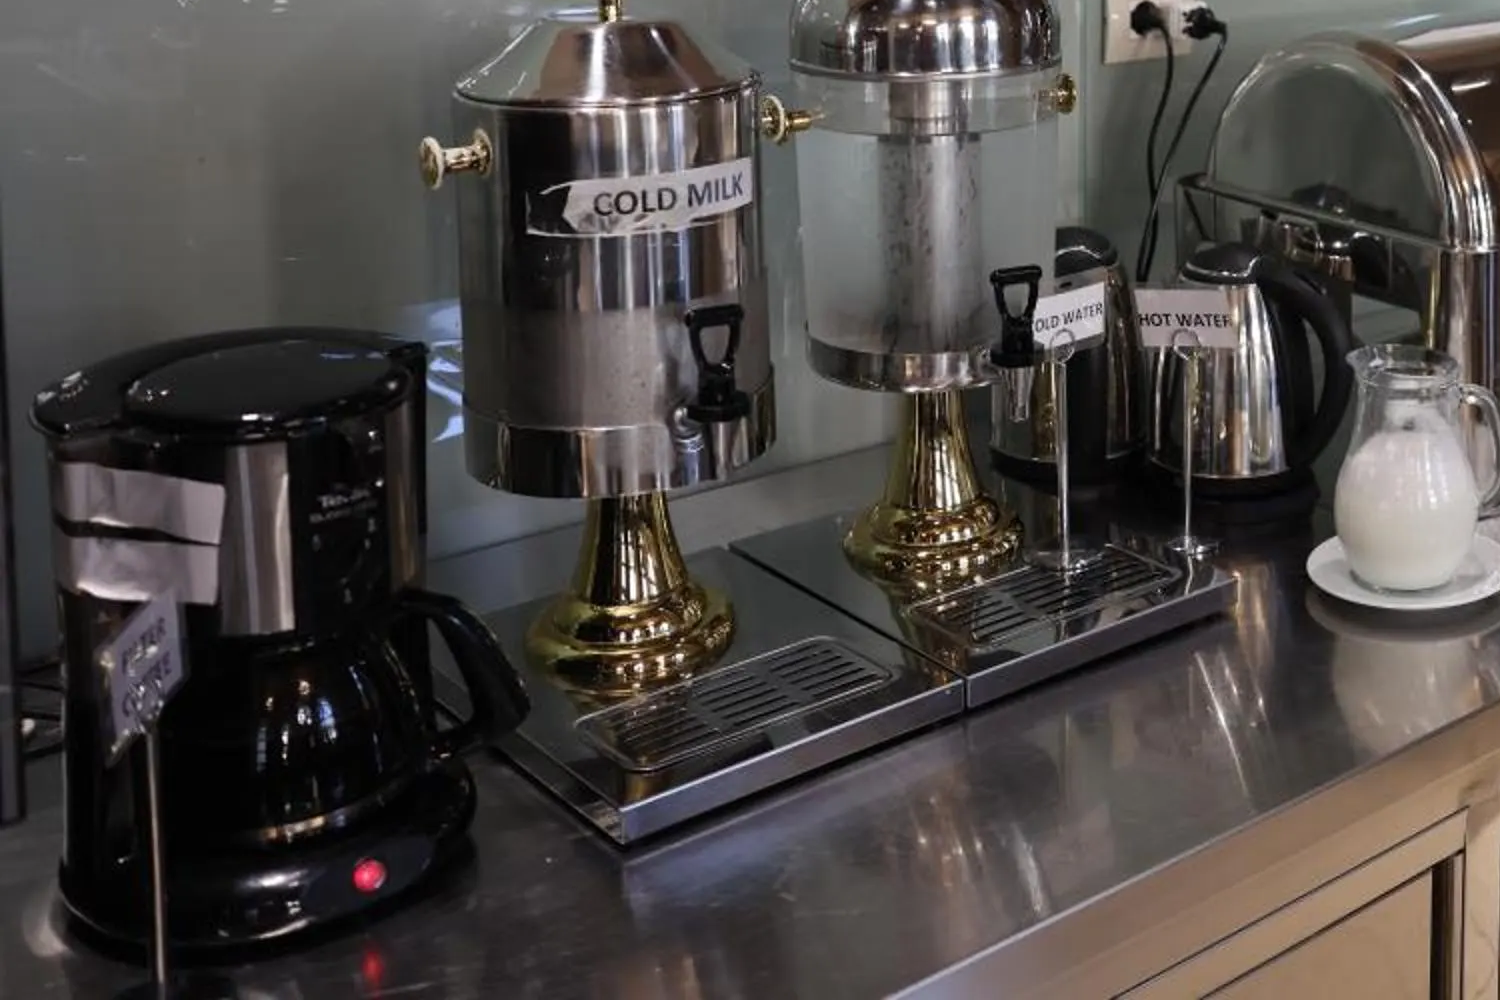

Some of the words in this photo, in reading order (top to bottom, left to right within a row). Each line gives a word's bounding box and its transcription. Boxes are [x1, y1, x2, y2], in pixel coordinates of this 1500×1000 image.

[593, 187, 677, 216] COLD
[687, 171, 744, 208] MILK
[1033, 315, 1060, 333] OLD
[1061, 302, 1103, 325] WATER
[1138, 312, 1172, 328] HOT
[1175, 313, 1233, 328] WATER
